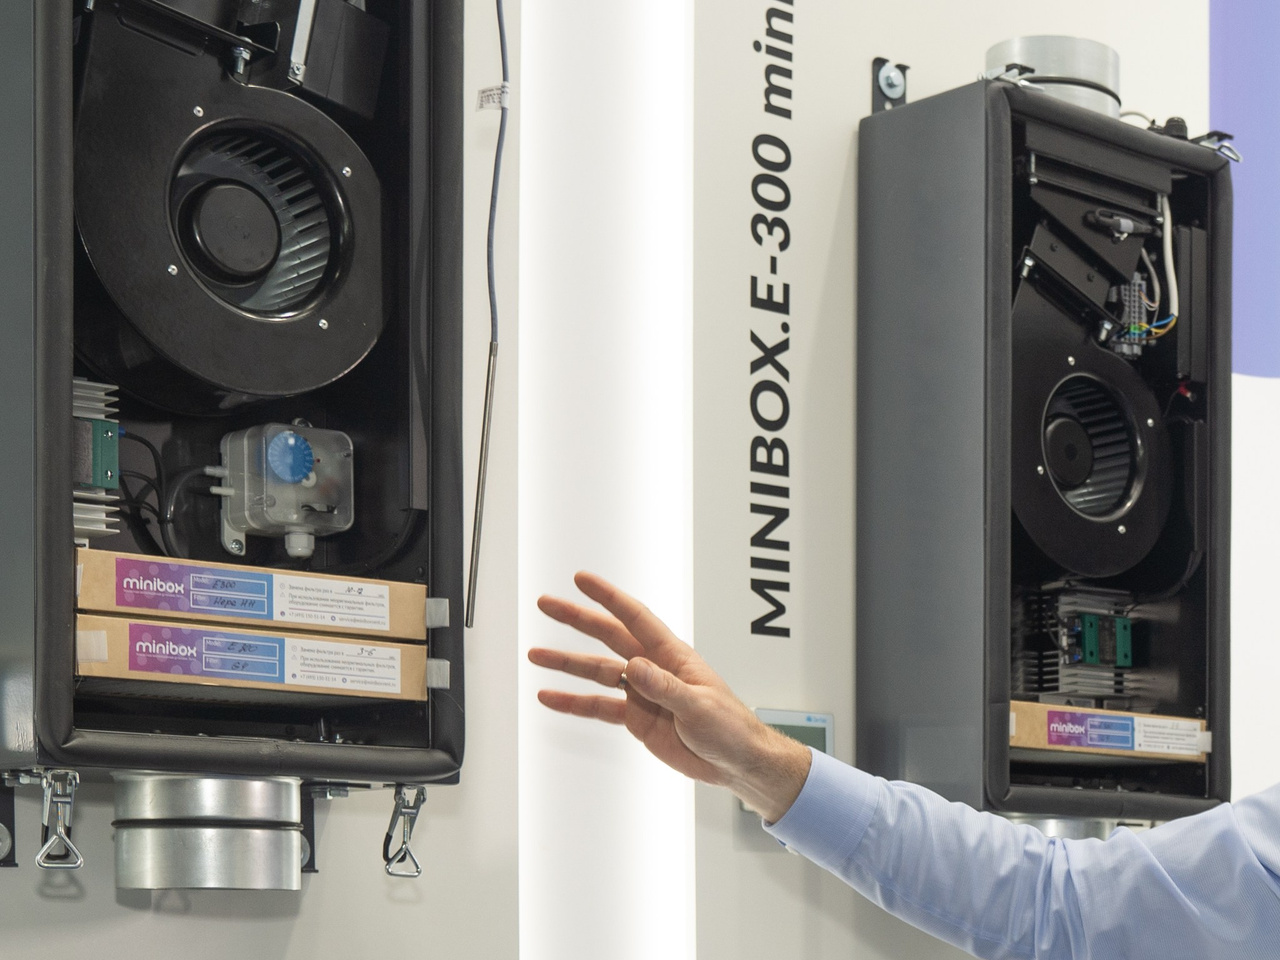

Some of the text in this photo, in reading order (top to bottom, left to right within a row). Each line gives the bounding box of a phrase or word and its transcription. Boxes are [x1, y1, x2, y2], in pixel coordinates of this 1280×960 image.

[749, 0, 794, 638] MINIBOX.E-300 min
[123, 576, 184, 594] minibox
[136, 639, 197, 657] minibox
[1050, 722, 1085, 735] minibox
